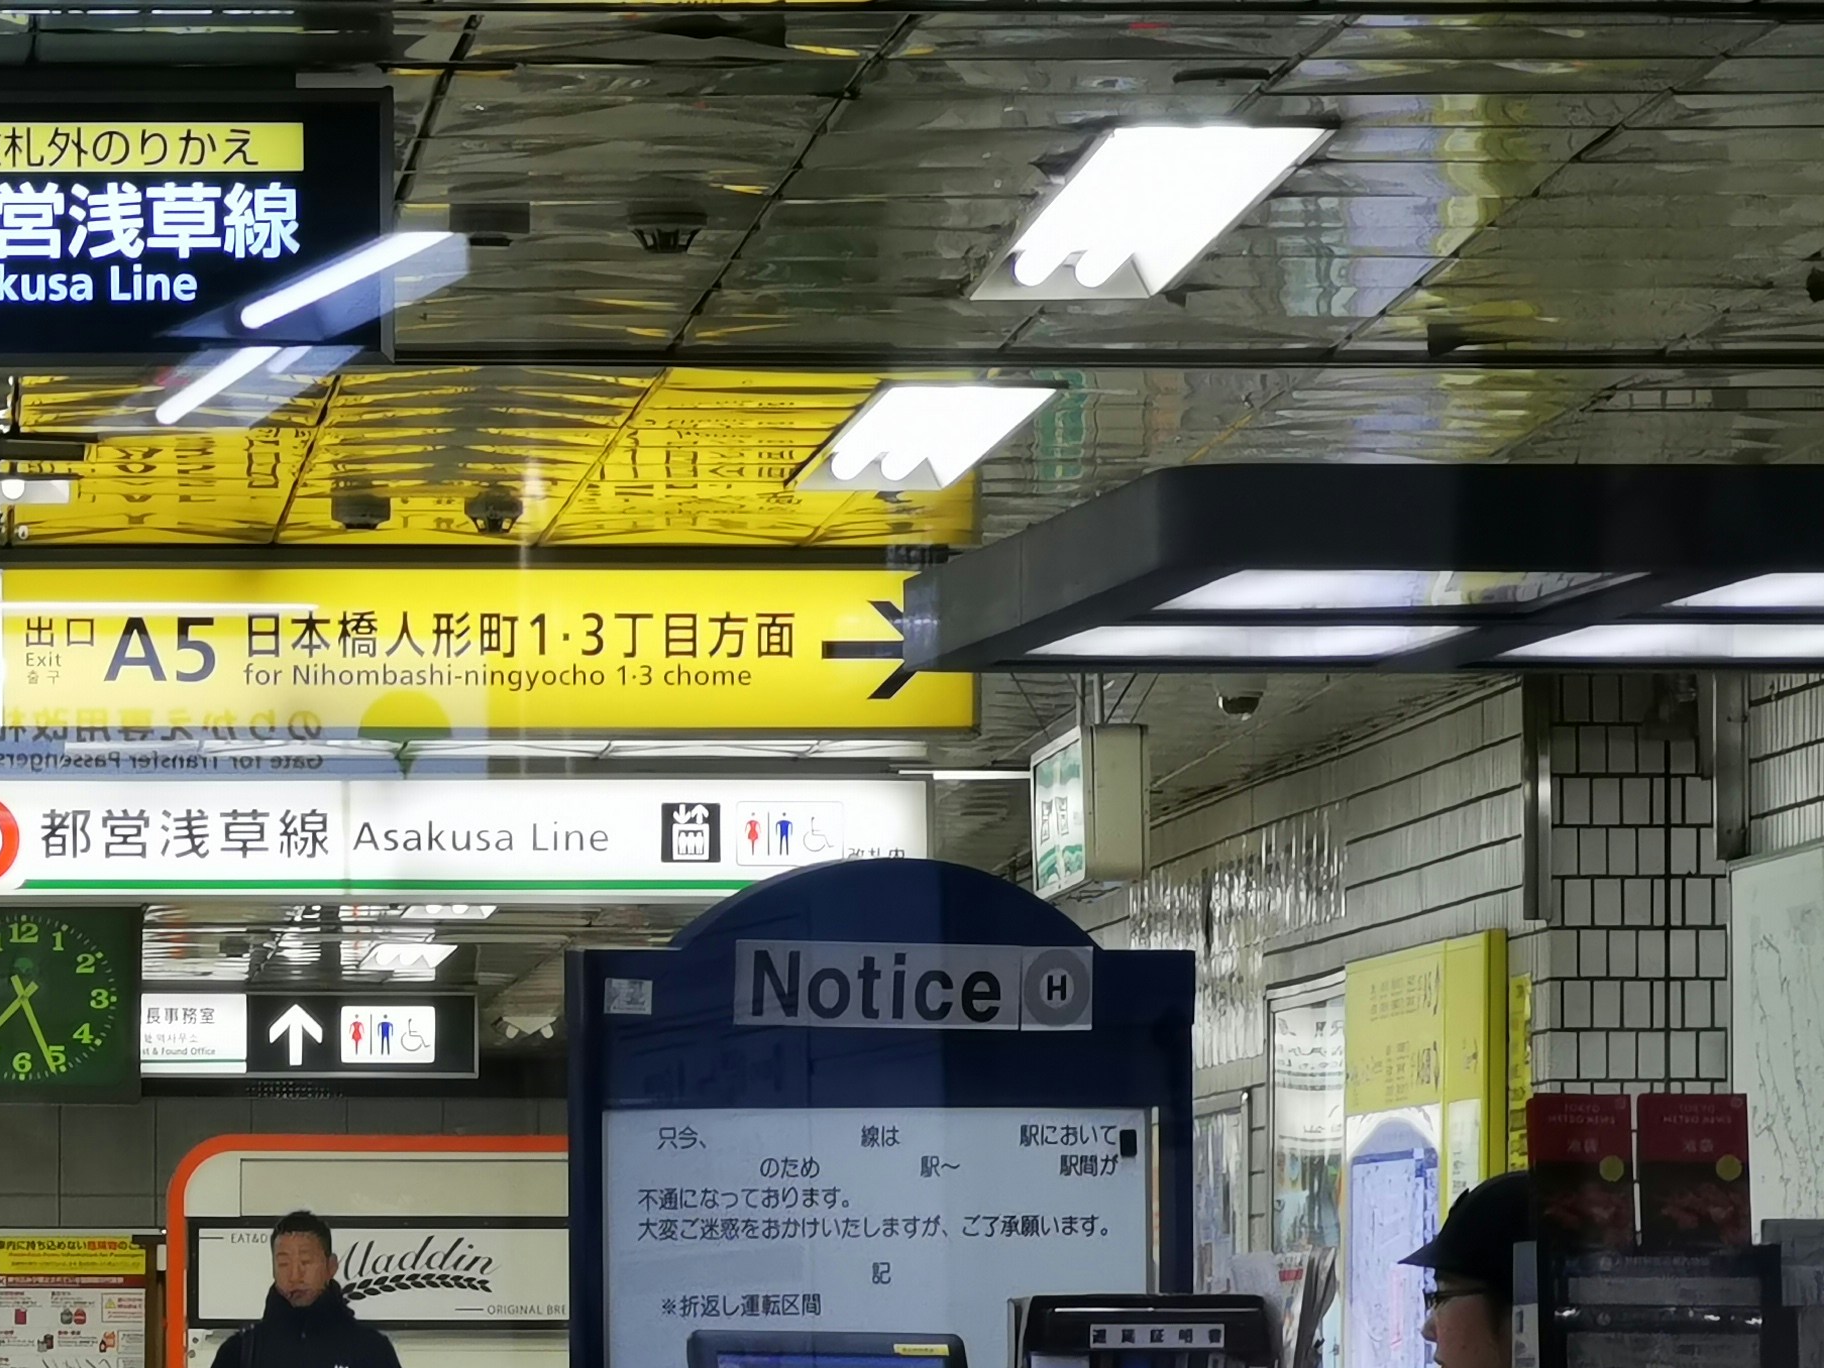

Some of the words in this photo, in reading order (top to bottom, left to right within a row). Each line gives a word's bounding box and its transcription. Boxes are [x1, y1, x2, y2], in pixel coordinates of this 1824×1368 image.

[110, 265, 198, 301] Line
[24, 616, 96, 647] 出口
[24, 652, 63, 668] Exit
[104, 615, 218, 683] A5
[243, 663, 282, 688] for
[290, 663, 608, 691] Nihombashi-ningyocho
[662, 663, 752, 688] chome
[39, 808, 330, 861] 都営浅草線
[352, 822, 515, 854] Asakusa
[530, 822, 610, 854] Line
[10, 923, 39, 943] 12
[52, 931, 65, 952] 1
[76, 954, 96, 975] 2
[751, 949, 1002, 1023] Notice
[90, 989, 110, 1009] 3
[73, 1023, 94, 1045] 4
[11, 1052, 32, 1074] 6
[49, 1046, 67, 1066] 5
[190, 1047, 216, 1056] Office
[657, 1126, 707, 1151] 只今、
[860, 1125, 900, 1149] 線は
[1020, 1125, 1118, 1147] 駅において
[760, 1157, 821, 1180] のため
[1059, 1155, 1119, 1178] 駅間が
[638, 1187, 853, 1211] 不通になっております。
[871, 1262, 893, 1286] 記
[486, 1304, 543, 1316] ORIGINAL
